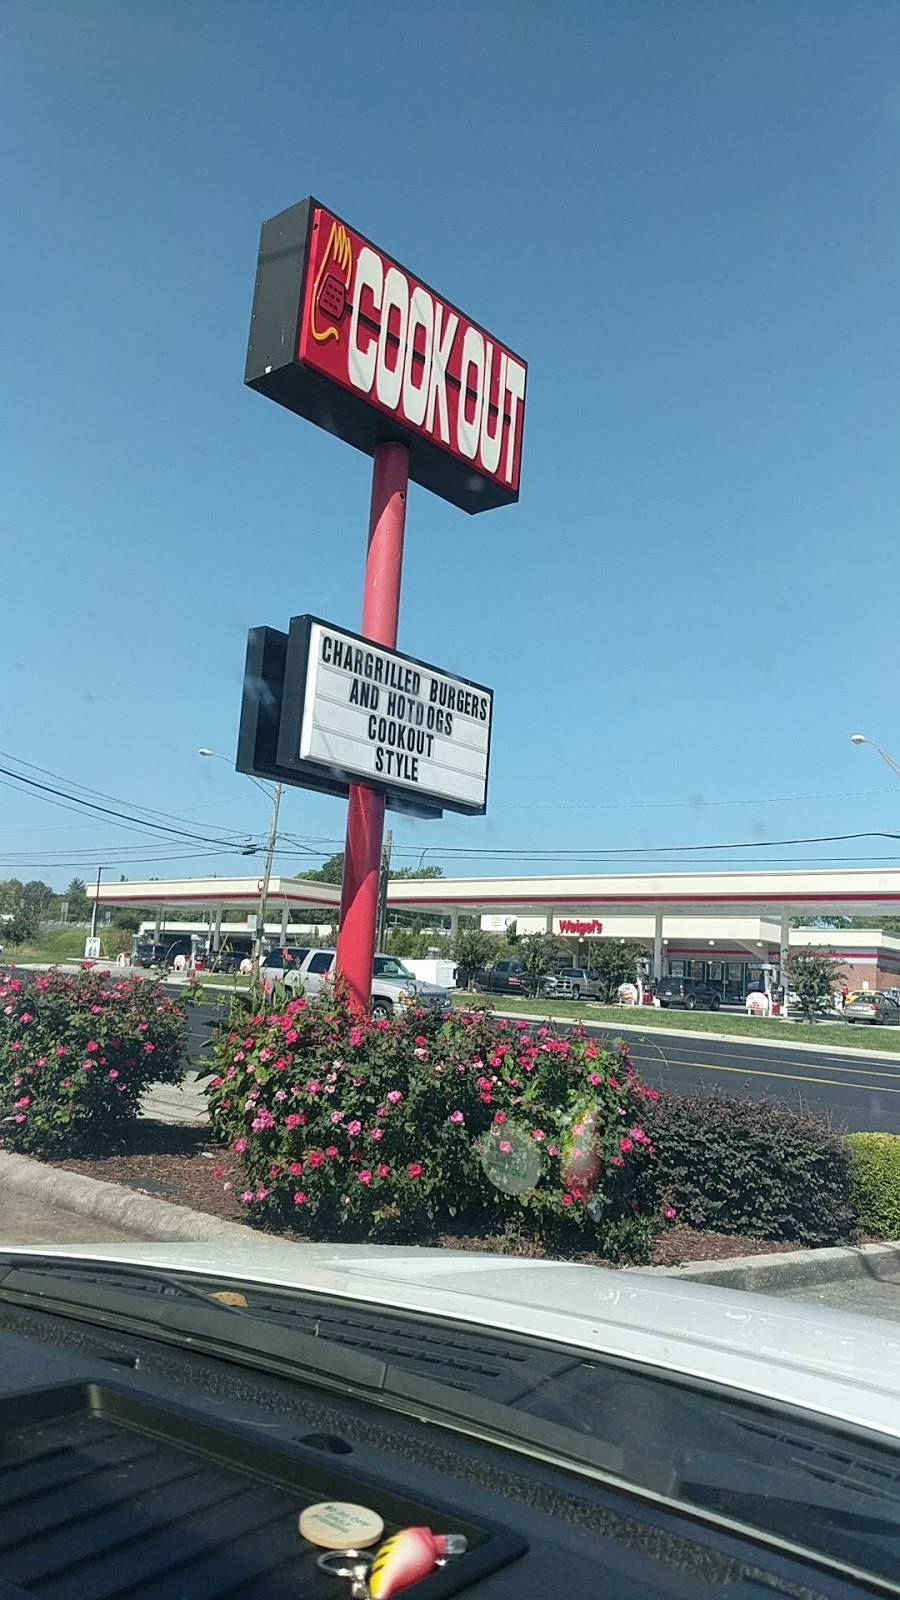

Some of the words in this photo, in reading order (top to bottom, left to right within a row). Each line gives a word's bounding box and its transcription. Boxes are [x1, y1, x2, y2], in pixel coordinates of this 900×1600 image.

[348, 247, 459, 445] COOK
[458, 327, 526, 484] OUT
[322, 637, 420, 695] CHARGRILLED
[430, 679, 487, 720] BURGERS
[350, 679, 379, 711] AND
[387, 691, 452, 735] HOTDOGS
[368, 715, 434, 757] COOKOUT
[375, 747, 418, 782] STYLE
[559, 919, 602, 935] Weigel's
